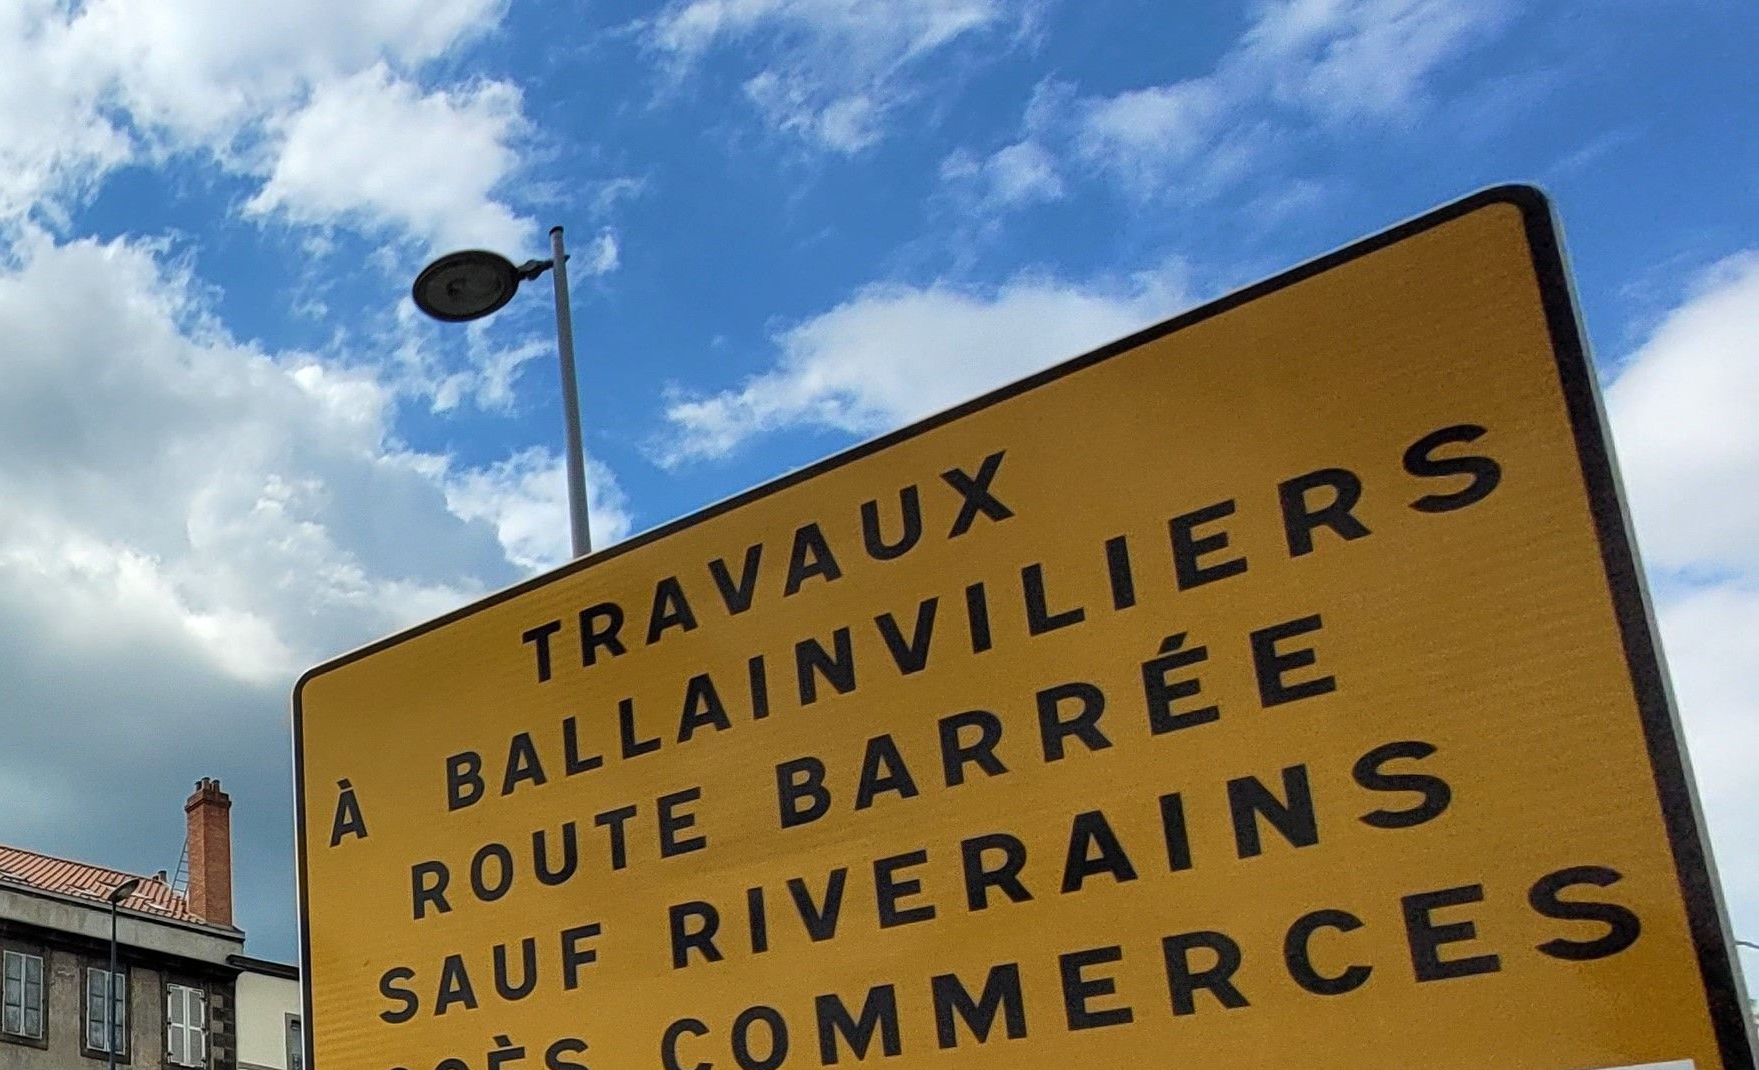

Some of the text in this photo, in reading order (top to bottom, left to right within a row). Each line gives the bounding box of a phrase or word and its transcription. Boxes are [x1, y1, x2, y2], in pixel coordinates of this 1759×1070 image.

[329, 423, 1503, 848] À BALLAINVILIERS
[521, 449, 1015, 684] TRAVAUX
[379, 740, 1452, 1024] SAUF RIVERAINS
[411, 613, 1337, 920] ROUTE BARRÉE
